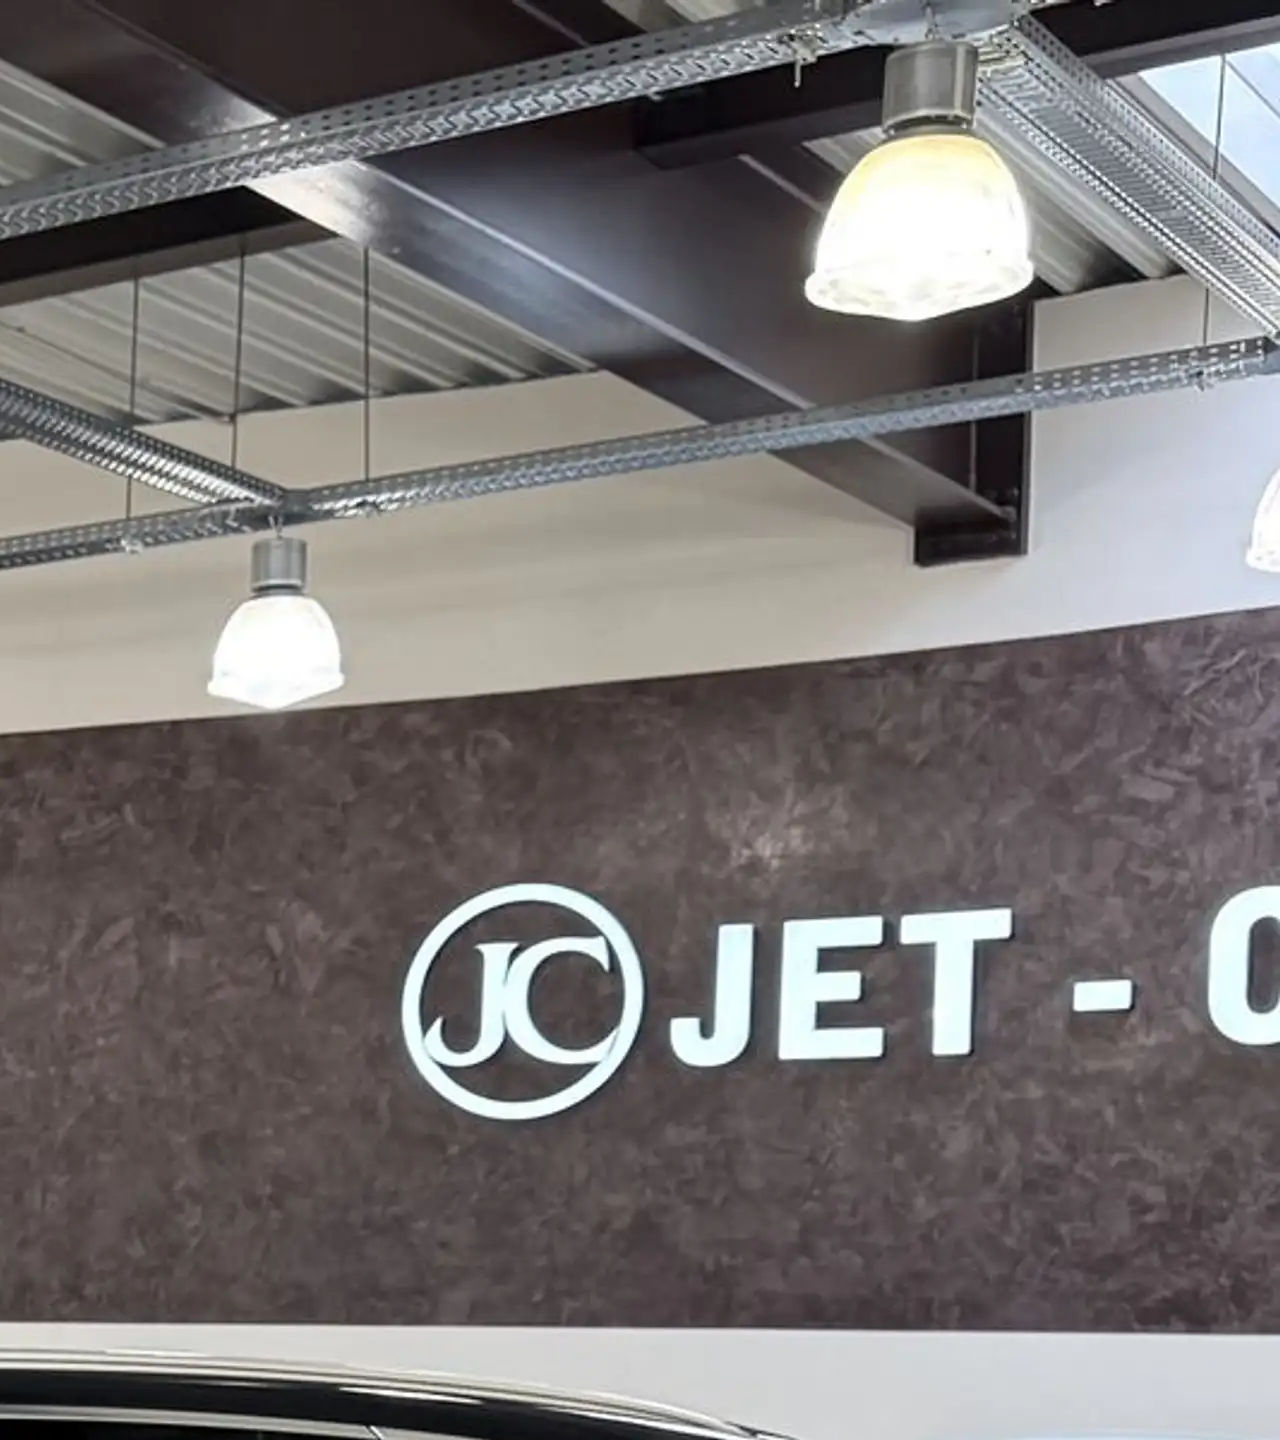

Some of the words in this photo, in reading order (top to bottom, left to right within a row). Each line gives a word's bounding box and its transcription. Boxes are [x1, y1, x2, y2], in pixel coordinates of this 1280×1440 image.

[423, 934, 621, 1067] JC
[669, 907, 1013, 1067] JET
[1072, 979, 1132, 1012] -
